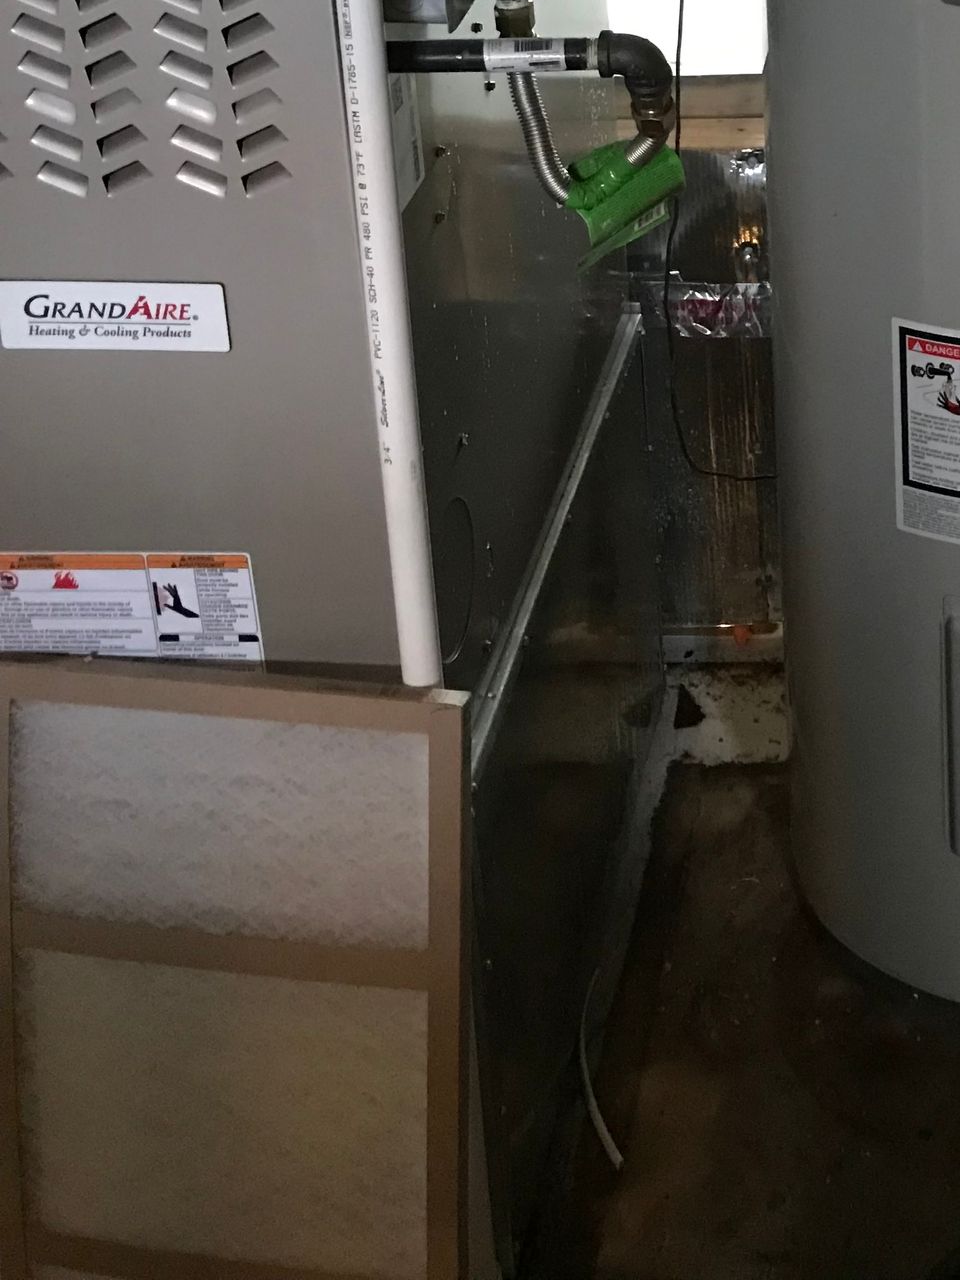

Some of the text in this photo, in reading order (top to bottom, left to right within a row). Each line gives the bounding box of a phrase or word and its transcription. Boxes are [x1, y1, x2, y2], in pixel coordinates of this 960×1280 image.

[345, 43, 359, 105] D-1785-15
[360, 196, 369, 216] PSI
[362, 222, 371, 240] 480
[364, 246, 373, 260] PR
[366, 266, 377, 304] SCH-40
[28, 324, 192, 340] Heating & Cooling Products
[370, 309, 382, 360] PVC-1120
